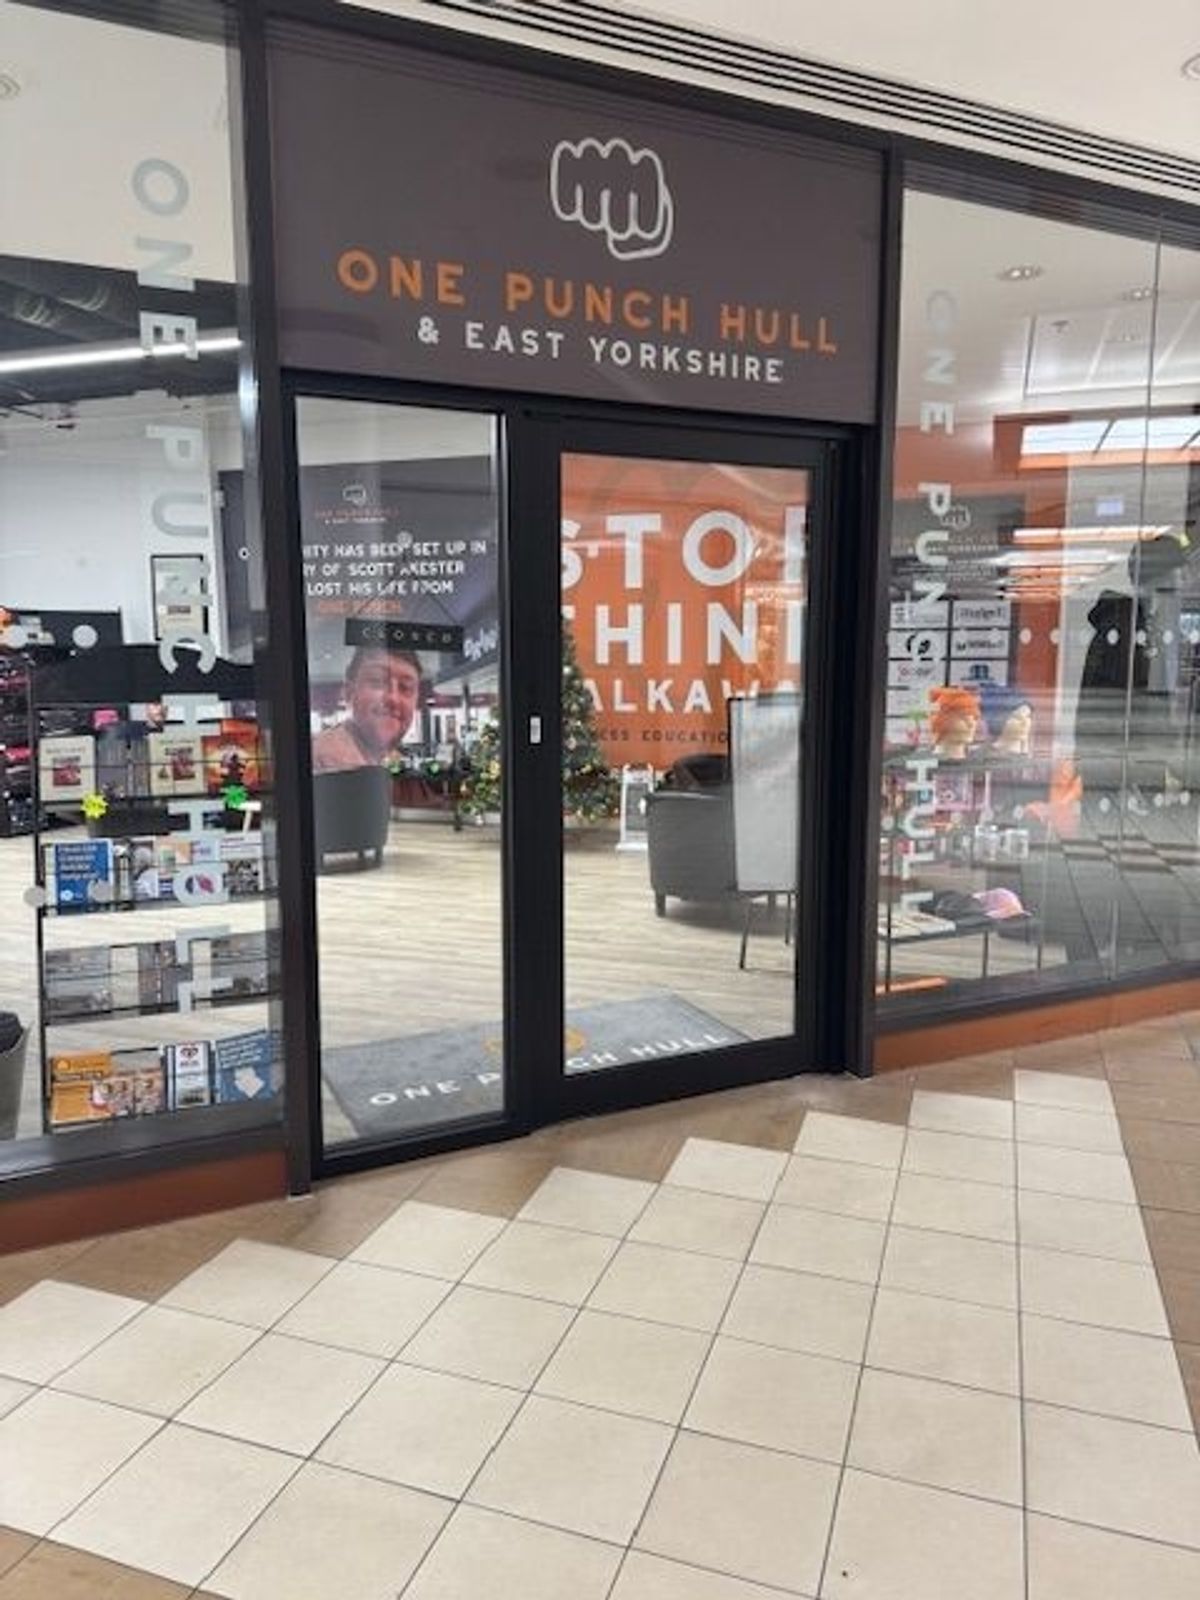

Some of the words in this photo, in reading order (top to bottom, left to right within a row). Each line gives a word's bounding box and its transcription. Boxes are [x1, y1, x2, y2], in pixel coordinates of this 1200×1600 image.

[131, 157, 199, 362] ONE
[337, 249, 467, 306] ONE
[506, 272, 691, 335] PUNCH
[720, 302, 838, 355] HULL
[417, 316, 440, 345] &
[466, 321, 565, 359] EAST
[589, 336, 784, 384] YORKSHIRE
[919, 288, 957, 436] ONE
[146, 423, 219, 737] PUNCH
[307, 581, 341, 597] LOST
[321, 562, 341, 576] OF
[348, 561, 395, 577] SCOTT
[412, 541, 441, 556] SET
[445, 540, 466, 555] UP
[470, 540, 487, 555] IN
[910, 482, 953, 714] PUNC
[900, 758, 939, 914] HULL
[167, 799, 233, 1014] HULL
[369, 1081, 462, 1108] ONE
[631, 1032, 731, 1058] HULL
